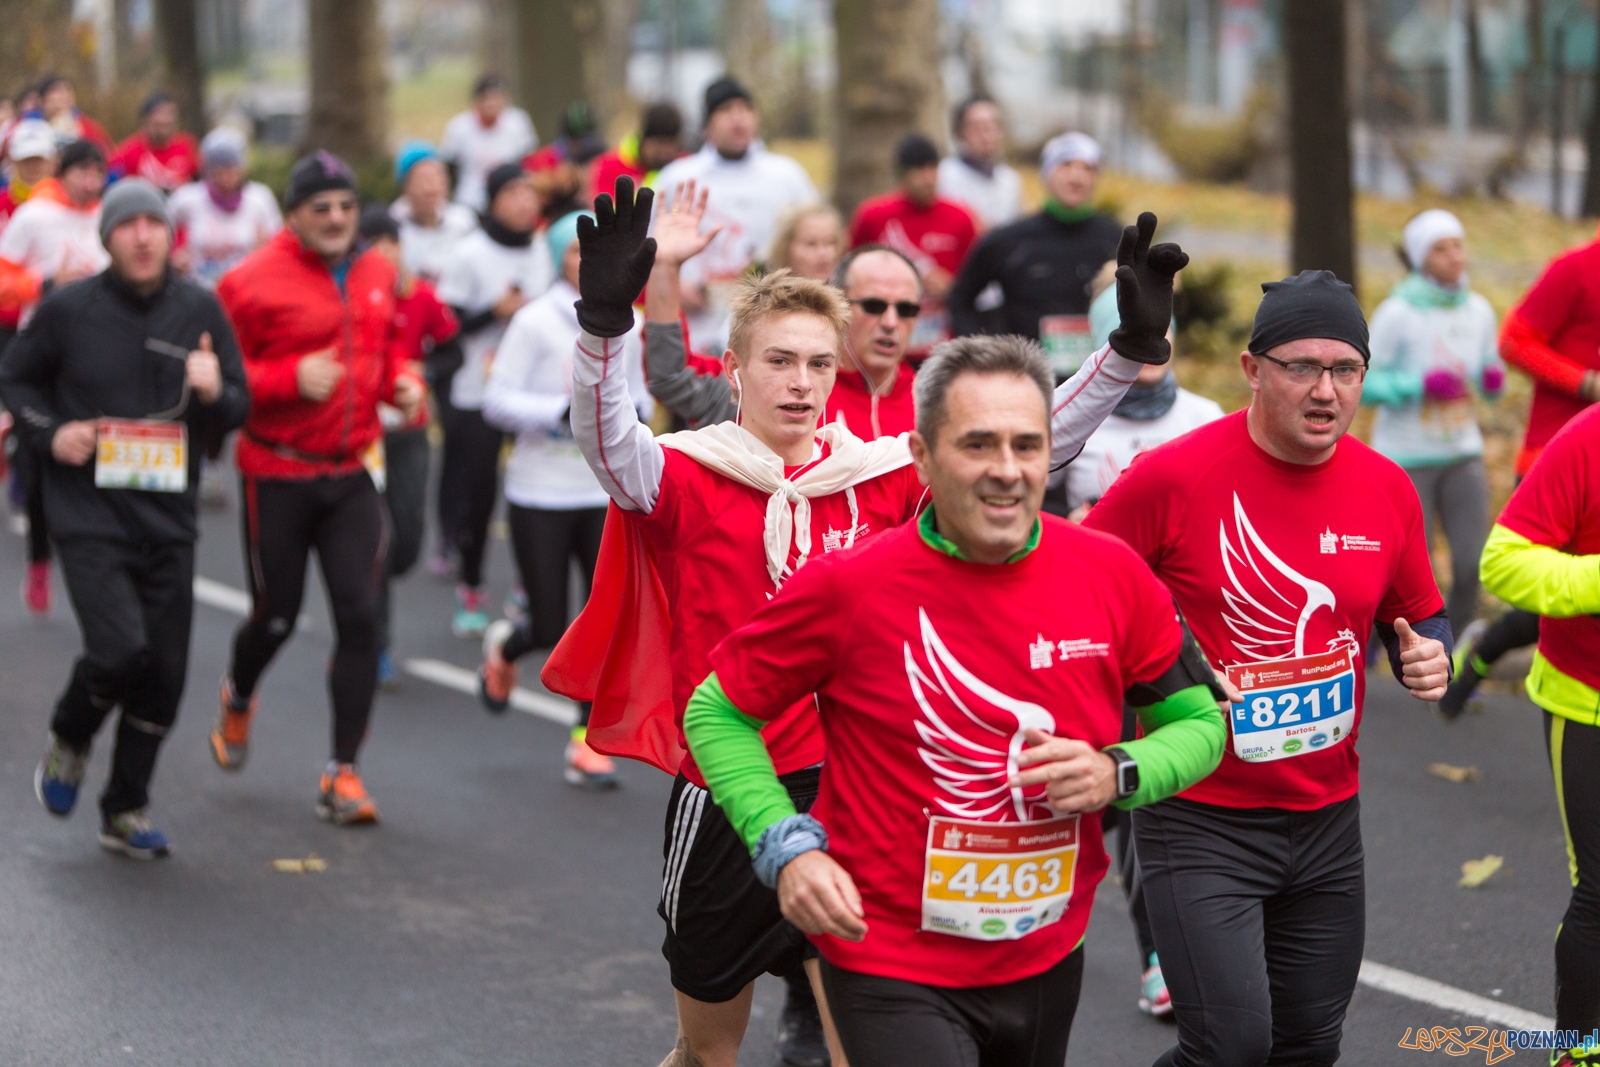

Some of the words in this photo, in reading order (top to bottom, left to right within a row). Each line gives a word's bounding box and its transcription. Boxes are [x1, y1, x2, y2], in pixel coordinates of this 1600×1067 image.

[1301, 658, 1346, 675] RunPoland.org
[1251, 682, 1341, 728] 8211
[1236, 709, 1246, 720] E
[1286, 726, 1317, 737] Bartosz
[1242, 747, 1263, 755] GRUPA
[1242, 752, 1268, 760] LUXMED
[1018, 830, 1070, 846] RunPoland.org
[947, 857, 1062, 899] 4463
